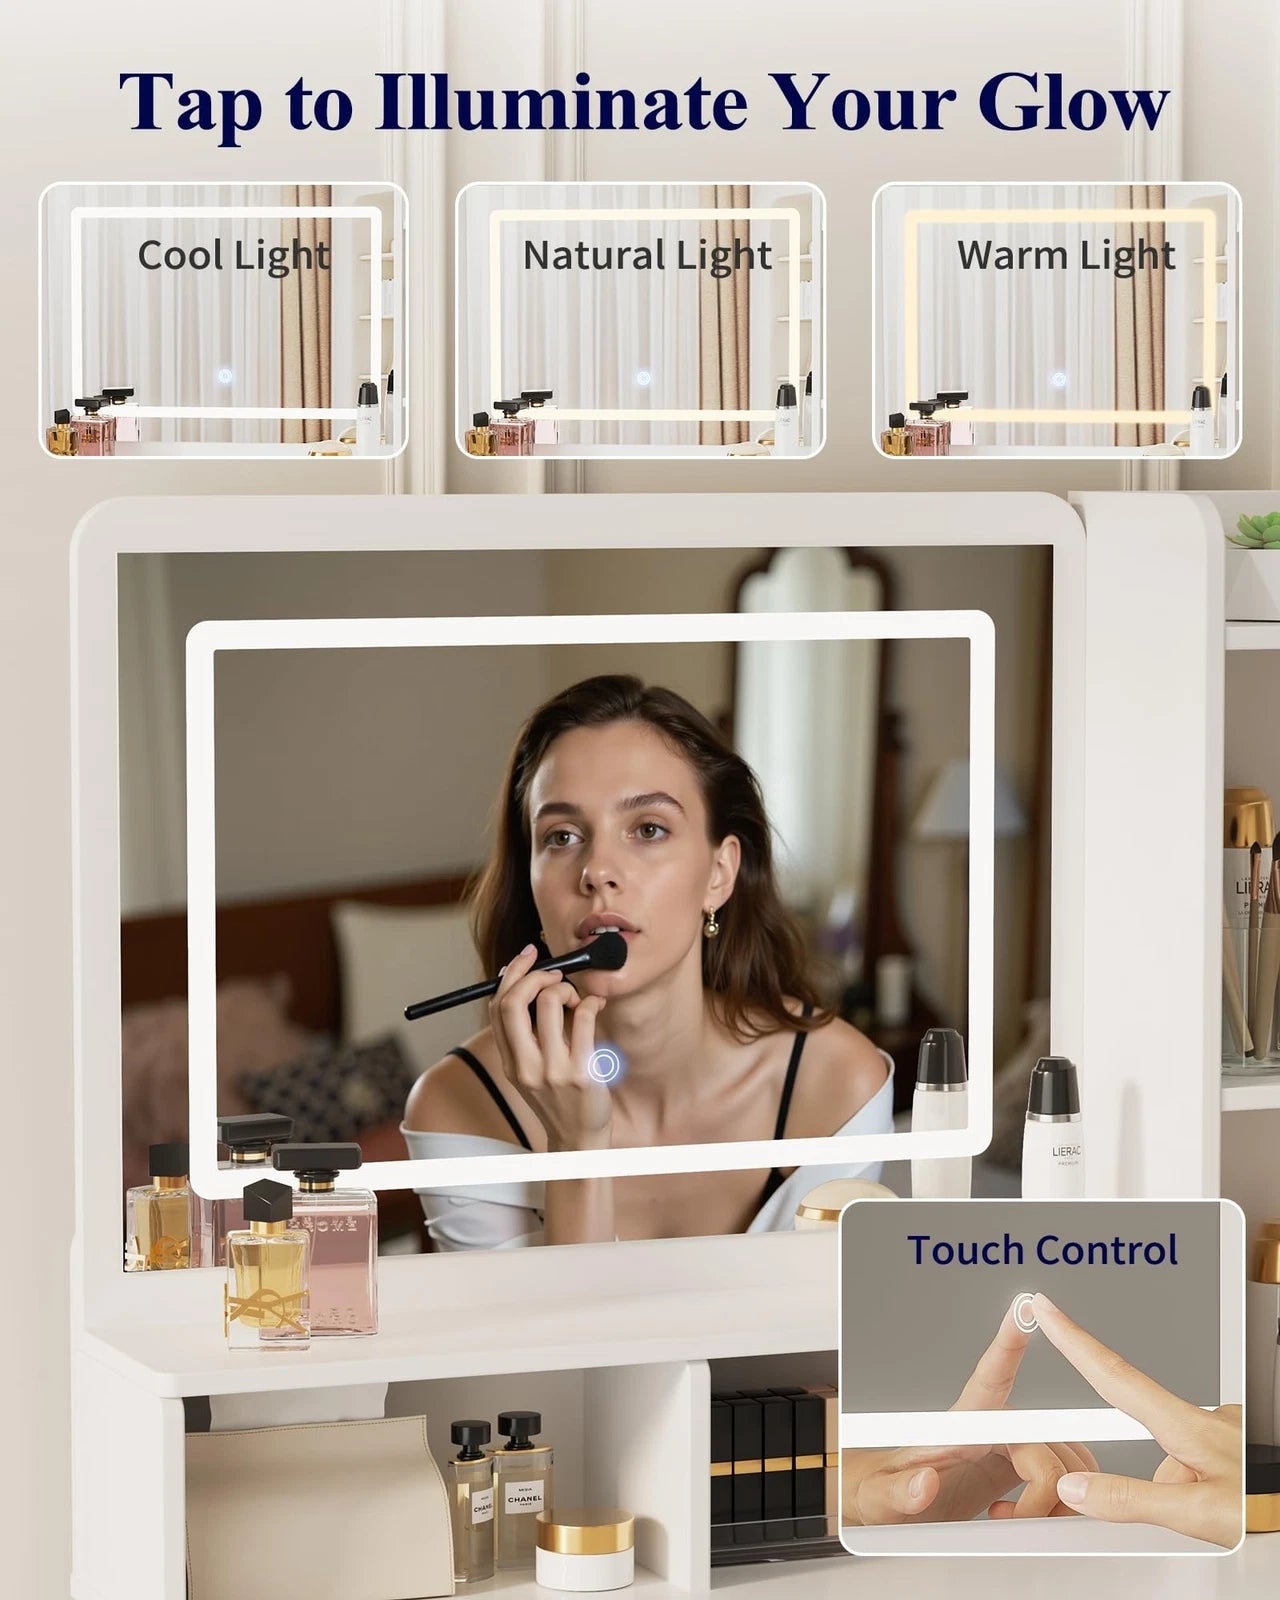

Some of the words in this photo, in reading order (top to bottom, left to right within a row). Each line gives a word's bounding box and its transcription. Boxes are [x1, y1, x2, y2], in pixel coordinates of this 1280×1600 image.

[1236, 881, 1270, 894] LIRA
[1052, 1145, 1081, 1157] LIERAC
[507, 1495, 542, 1503] CHANEL
